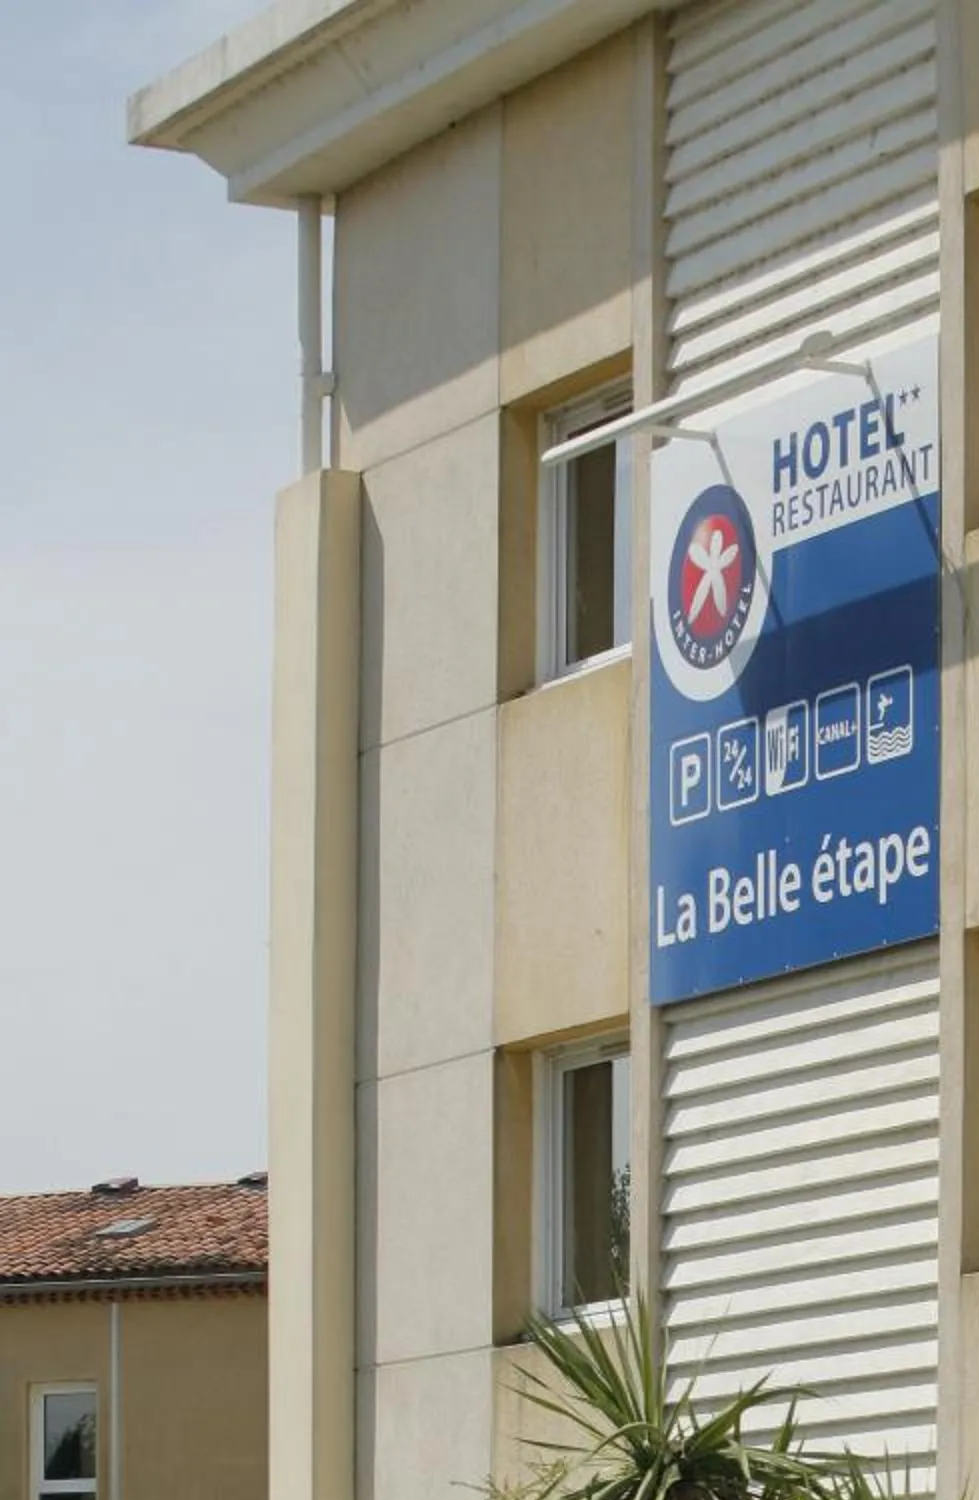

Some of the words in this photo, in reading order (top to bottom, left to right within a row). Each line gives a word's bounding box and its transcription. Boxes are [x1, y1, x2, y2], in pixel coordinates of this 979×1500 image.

[772, 393, 905, 494] HOTEL
[772, 444, 933, 537] RESTAURANT
[681, 754, 701, 807] P
[657, 884, 697, 948] La
[709, 849, 800, 934] Belle
[812, 825, 930, 904] étape
